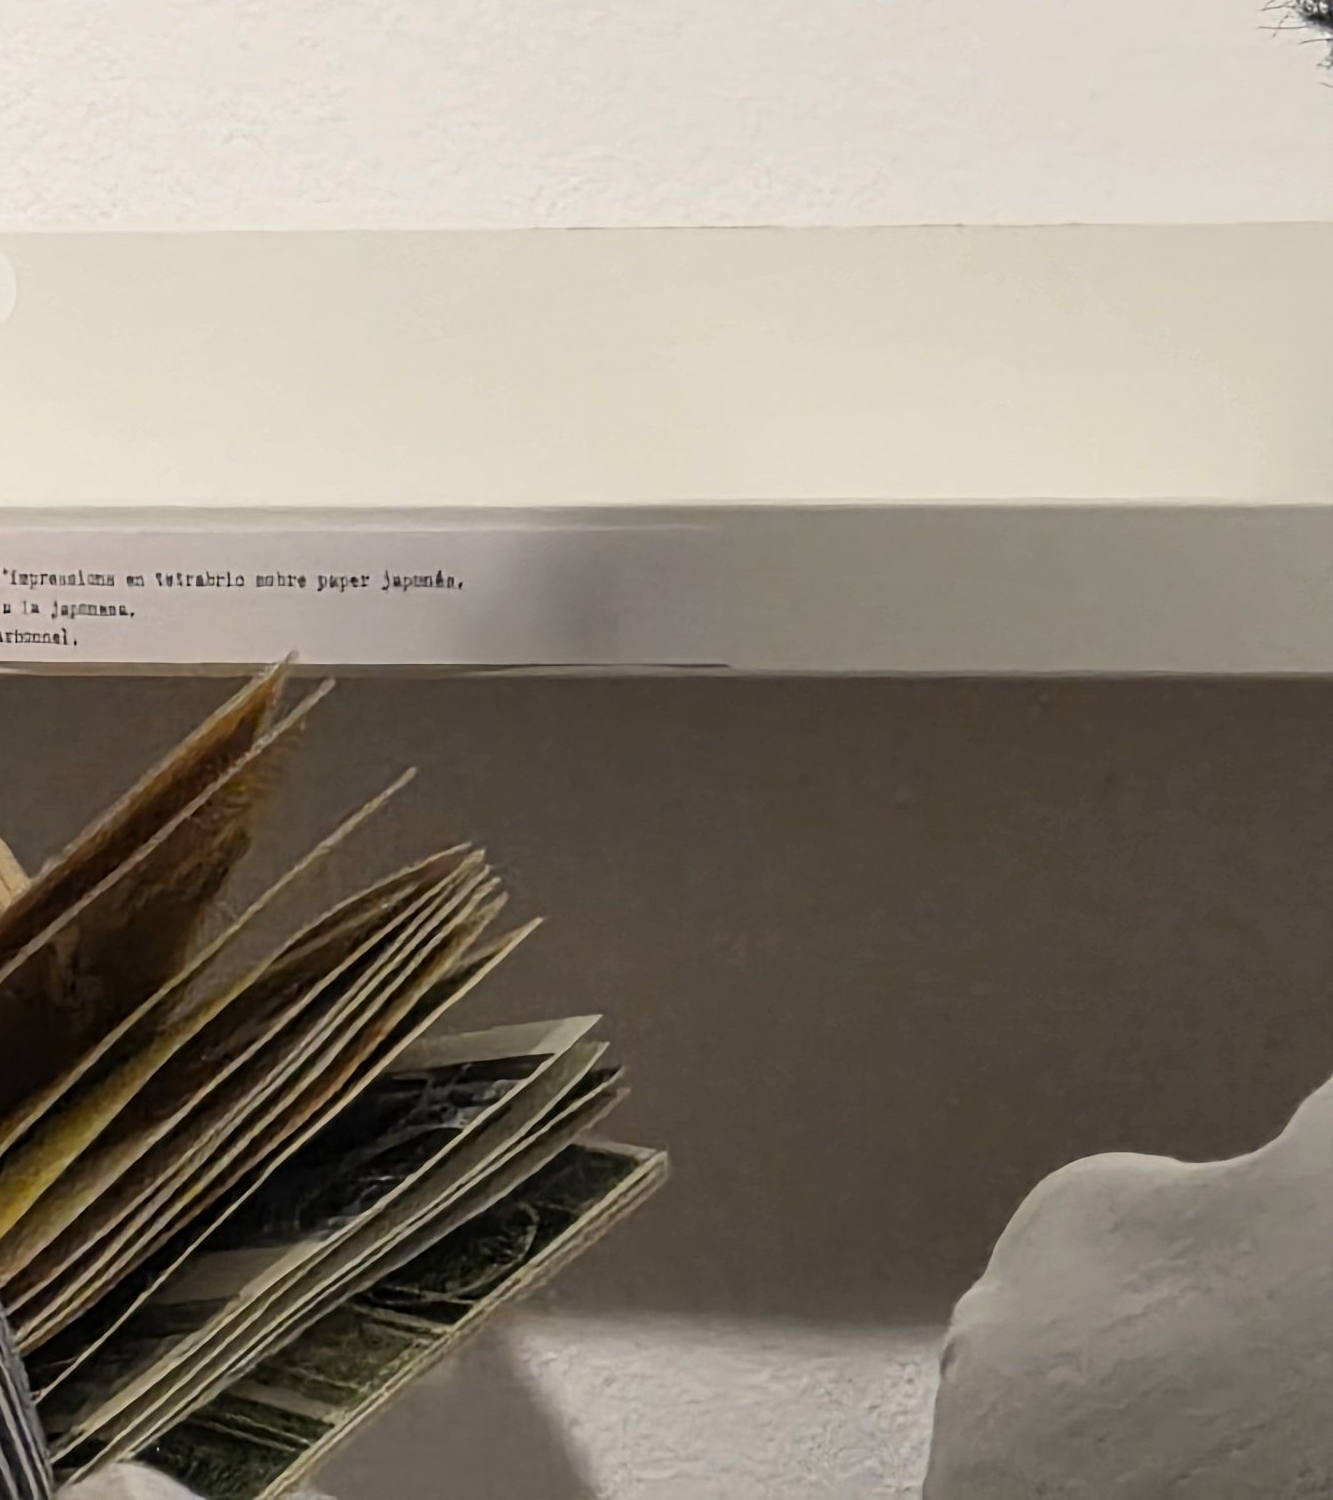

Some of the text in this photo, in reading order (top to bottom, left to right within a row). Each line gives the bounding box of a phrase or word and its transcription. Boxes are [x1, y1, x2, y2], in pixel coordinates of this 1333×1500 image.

[126, 574, 145, 587] en
[256, 571, 307, 588] sobre
[317, 574, 370, 592] paper
[2, 602, 12, 614] a
[23, 600, 40, 614] la
